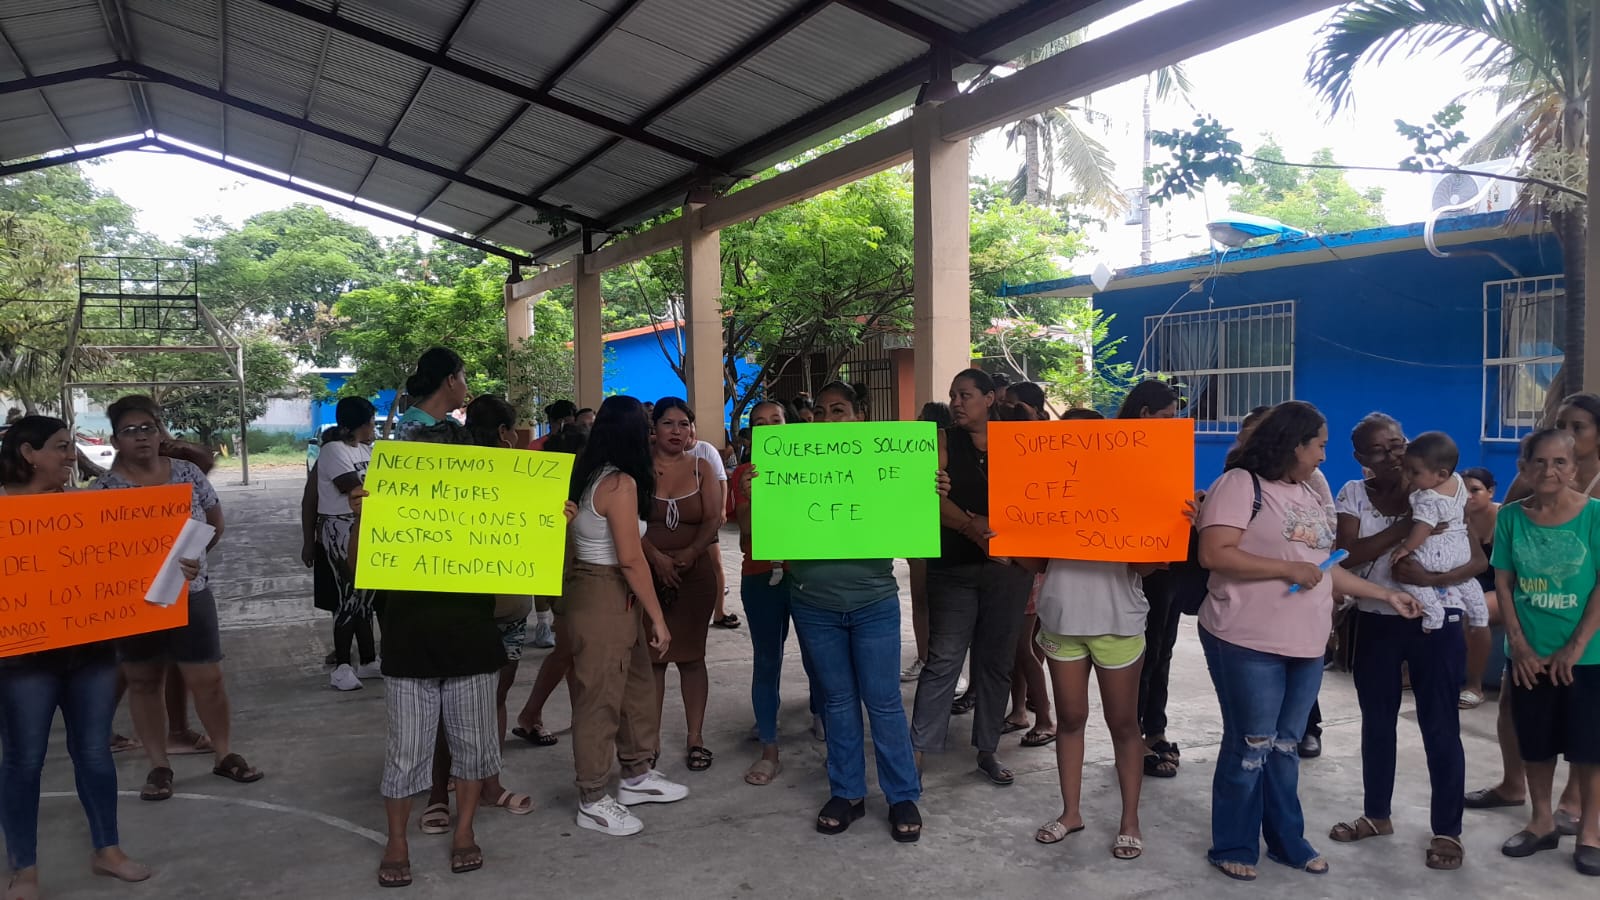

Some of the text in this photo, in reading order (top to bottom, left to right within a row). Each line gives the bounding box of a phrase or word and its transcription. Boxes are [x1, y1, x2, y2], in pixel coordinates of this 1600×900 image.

[764, 436, 935, 457] QUEREMOS SOLUCION
[1014, 430, 1149, 456] SUPERVISOR
[376, 453, 495, 473] NECESITAMOS
[513, 455, 561, 480] LUZ
[765, 466, 901, 486] INMEDIATA DE
[377, 479, 500, 501] PARA MEJORES
[1024, 480, 1080, 501] CFE
[397, 506, 556, 528] CONDICIONES DE
[807, 502, 864, 522] CFE
[1005, 505, 1120, 526] QUEREMOS
[371, 526, 453, 545] NUESTROS
[1075, 530, 1170, 550] SOLUCION
[4, 535, 173, 577] DEL SUPERVISOR
[370, 551, 535, 578] CFE ATIENDENOS
[50, 585, 82, 607] LOS
[1531, 593, 1578, 609] POWER
[0, 606, 137, 640] MBOS TURNOS
